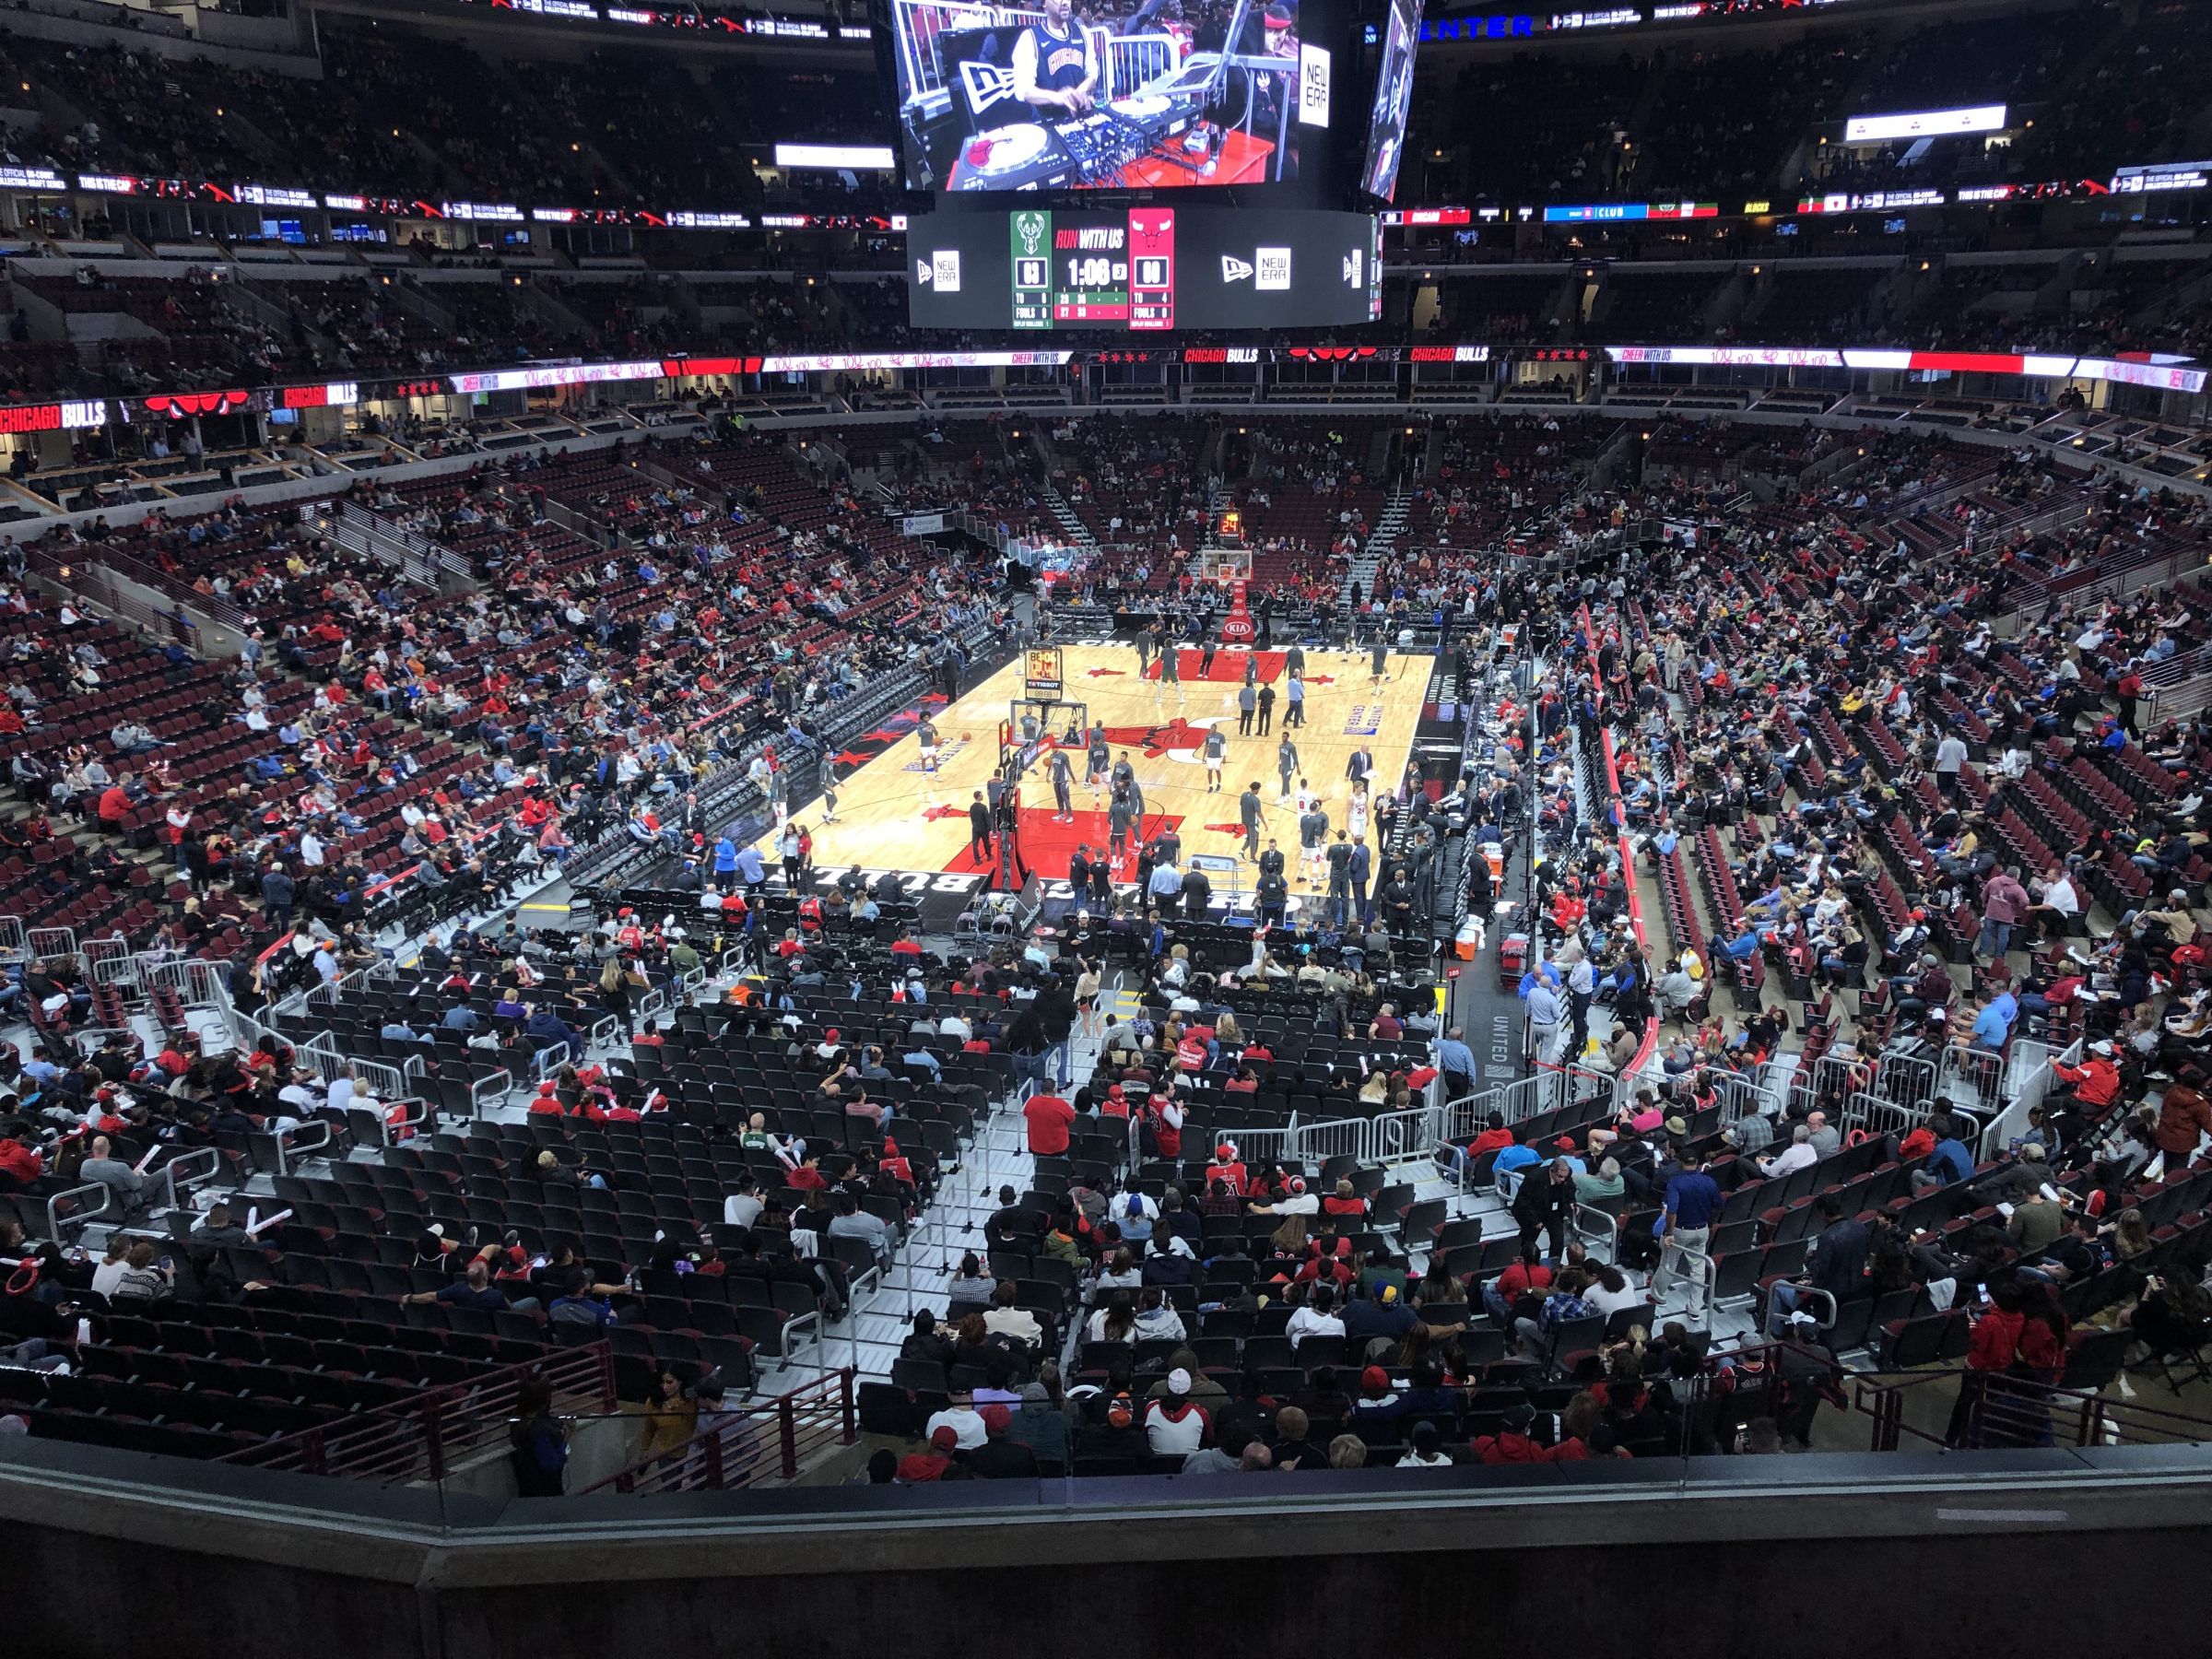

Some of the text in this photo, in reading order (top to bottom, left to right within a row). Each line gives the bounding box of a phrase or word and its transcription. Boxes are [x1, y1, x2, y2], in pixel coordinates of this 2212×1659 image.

[1419, 15, 1534, 41] ENTER
[1307, 63, 1327, 87] NEW
[1307, 87, 1327, 110] ERA
[1598, 207, 1624, 218] CLUB
[1745, 203, 1770, 213] BLOCKS
[1056, 229, 1124, 249] RUN WITH US
[937, 260, 956, 271] NEW
[1263, 258, 1286, 268] NEW
[938, 272, 956, 282] ERA
[1263, 270, 1286, 280] ERA
[1016, 293, 1024, 304] TO
[1134, 293, 1167, 303] TO 4
[1016, 308, 1035, 319] FOULS
[1134, 308, 1155, 318] FOULS
[1012, 353, 1059, 364] CHEER WITH US
[1184, 349, 1258, 362] CHICAGO BULLS
[1411, 347, 1488, 361] CHICAGO BULLS
[1622, 349, 1671, 361] CHEER WITH US
[285, 383, 358, 408] CHICAGO BULLS
[0, 402, 105, 433] CHICAGO BULLS
[1222, 522, 1237, 533] 24
[1230, 624, 1246, 633] KIA
[1348, 705, 1365, 725] CENTER
[1368, 706, 1384, 727] UNITED
[1448, 969, 1461, 977] 105
[1491, 1016, 1510, 1063] UNITED
